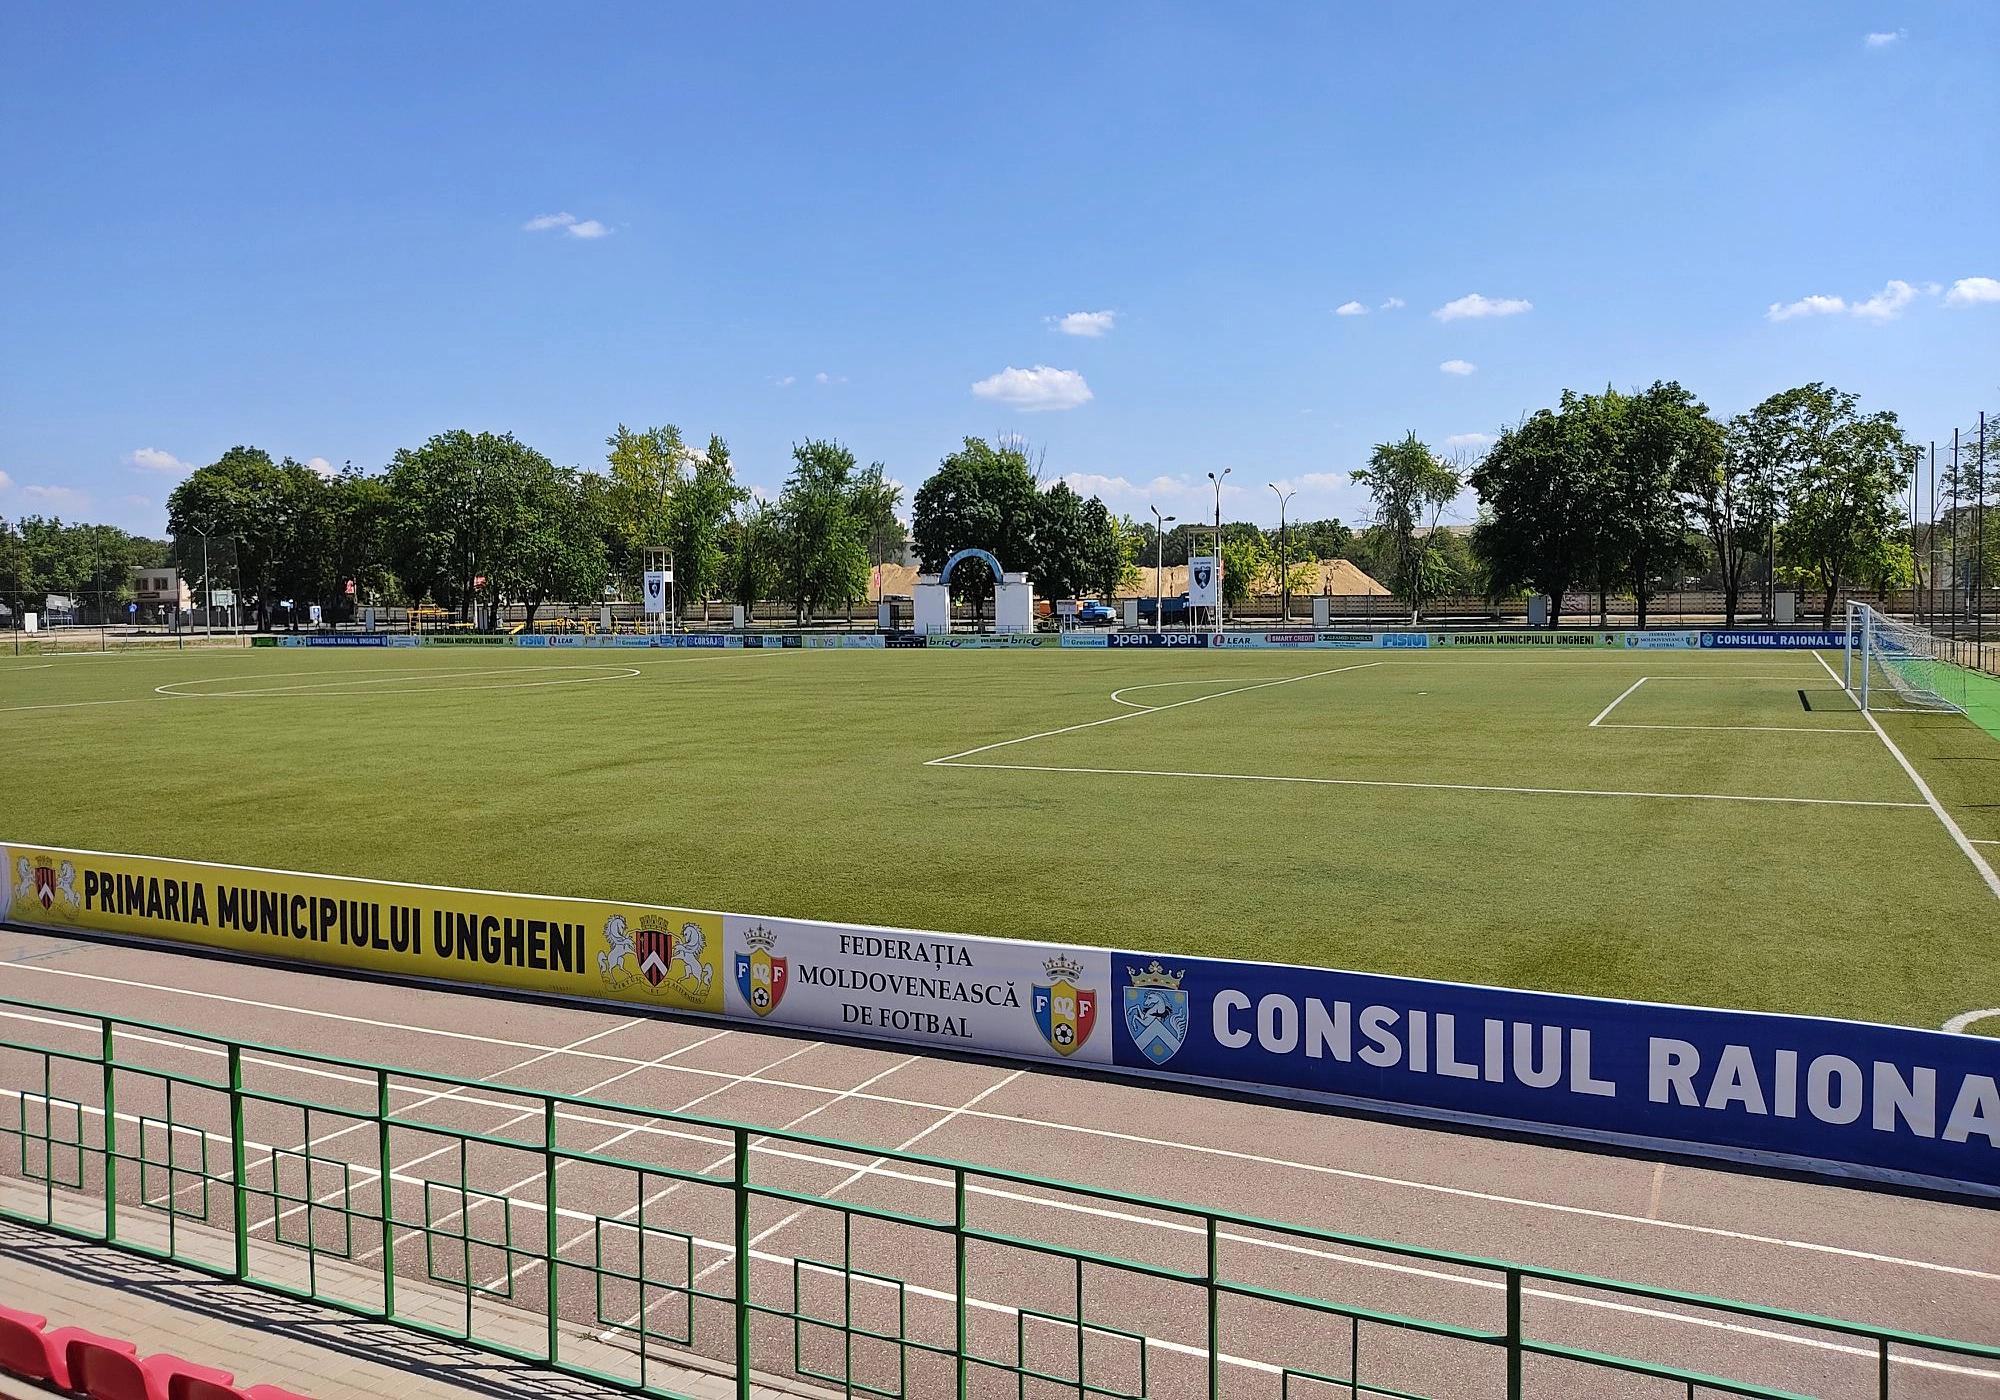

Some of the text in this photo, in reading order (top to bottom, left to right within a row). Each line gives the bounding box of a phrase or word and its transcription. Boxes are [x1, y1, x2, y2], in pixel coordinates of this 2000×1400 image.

[1227, 637, 1252, 645] LEAR
[1454, 635, 1594, 645] PRIMARIA MUNICIPIULUI UNGHENI
[1717, 634, 1777, 645] CONSILIUL
[1780, 636, 1831, 646] RAIONAL
[84, 869, 208, 927] PRIMARIA
[217, 885, 422, 956] MUNICIPIULUI
[434, 911, 586, 975] UNGHENI
[839, 934, 973, 971] FEDERAȚIA
[797, 965, 1021, 1009] MOLDOVENEASCĂ
[841, 1003, 973, 1039] DE FOTBAL
[1212, 989, 2000, 1150] CONSILIUL RAIONA
